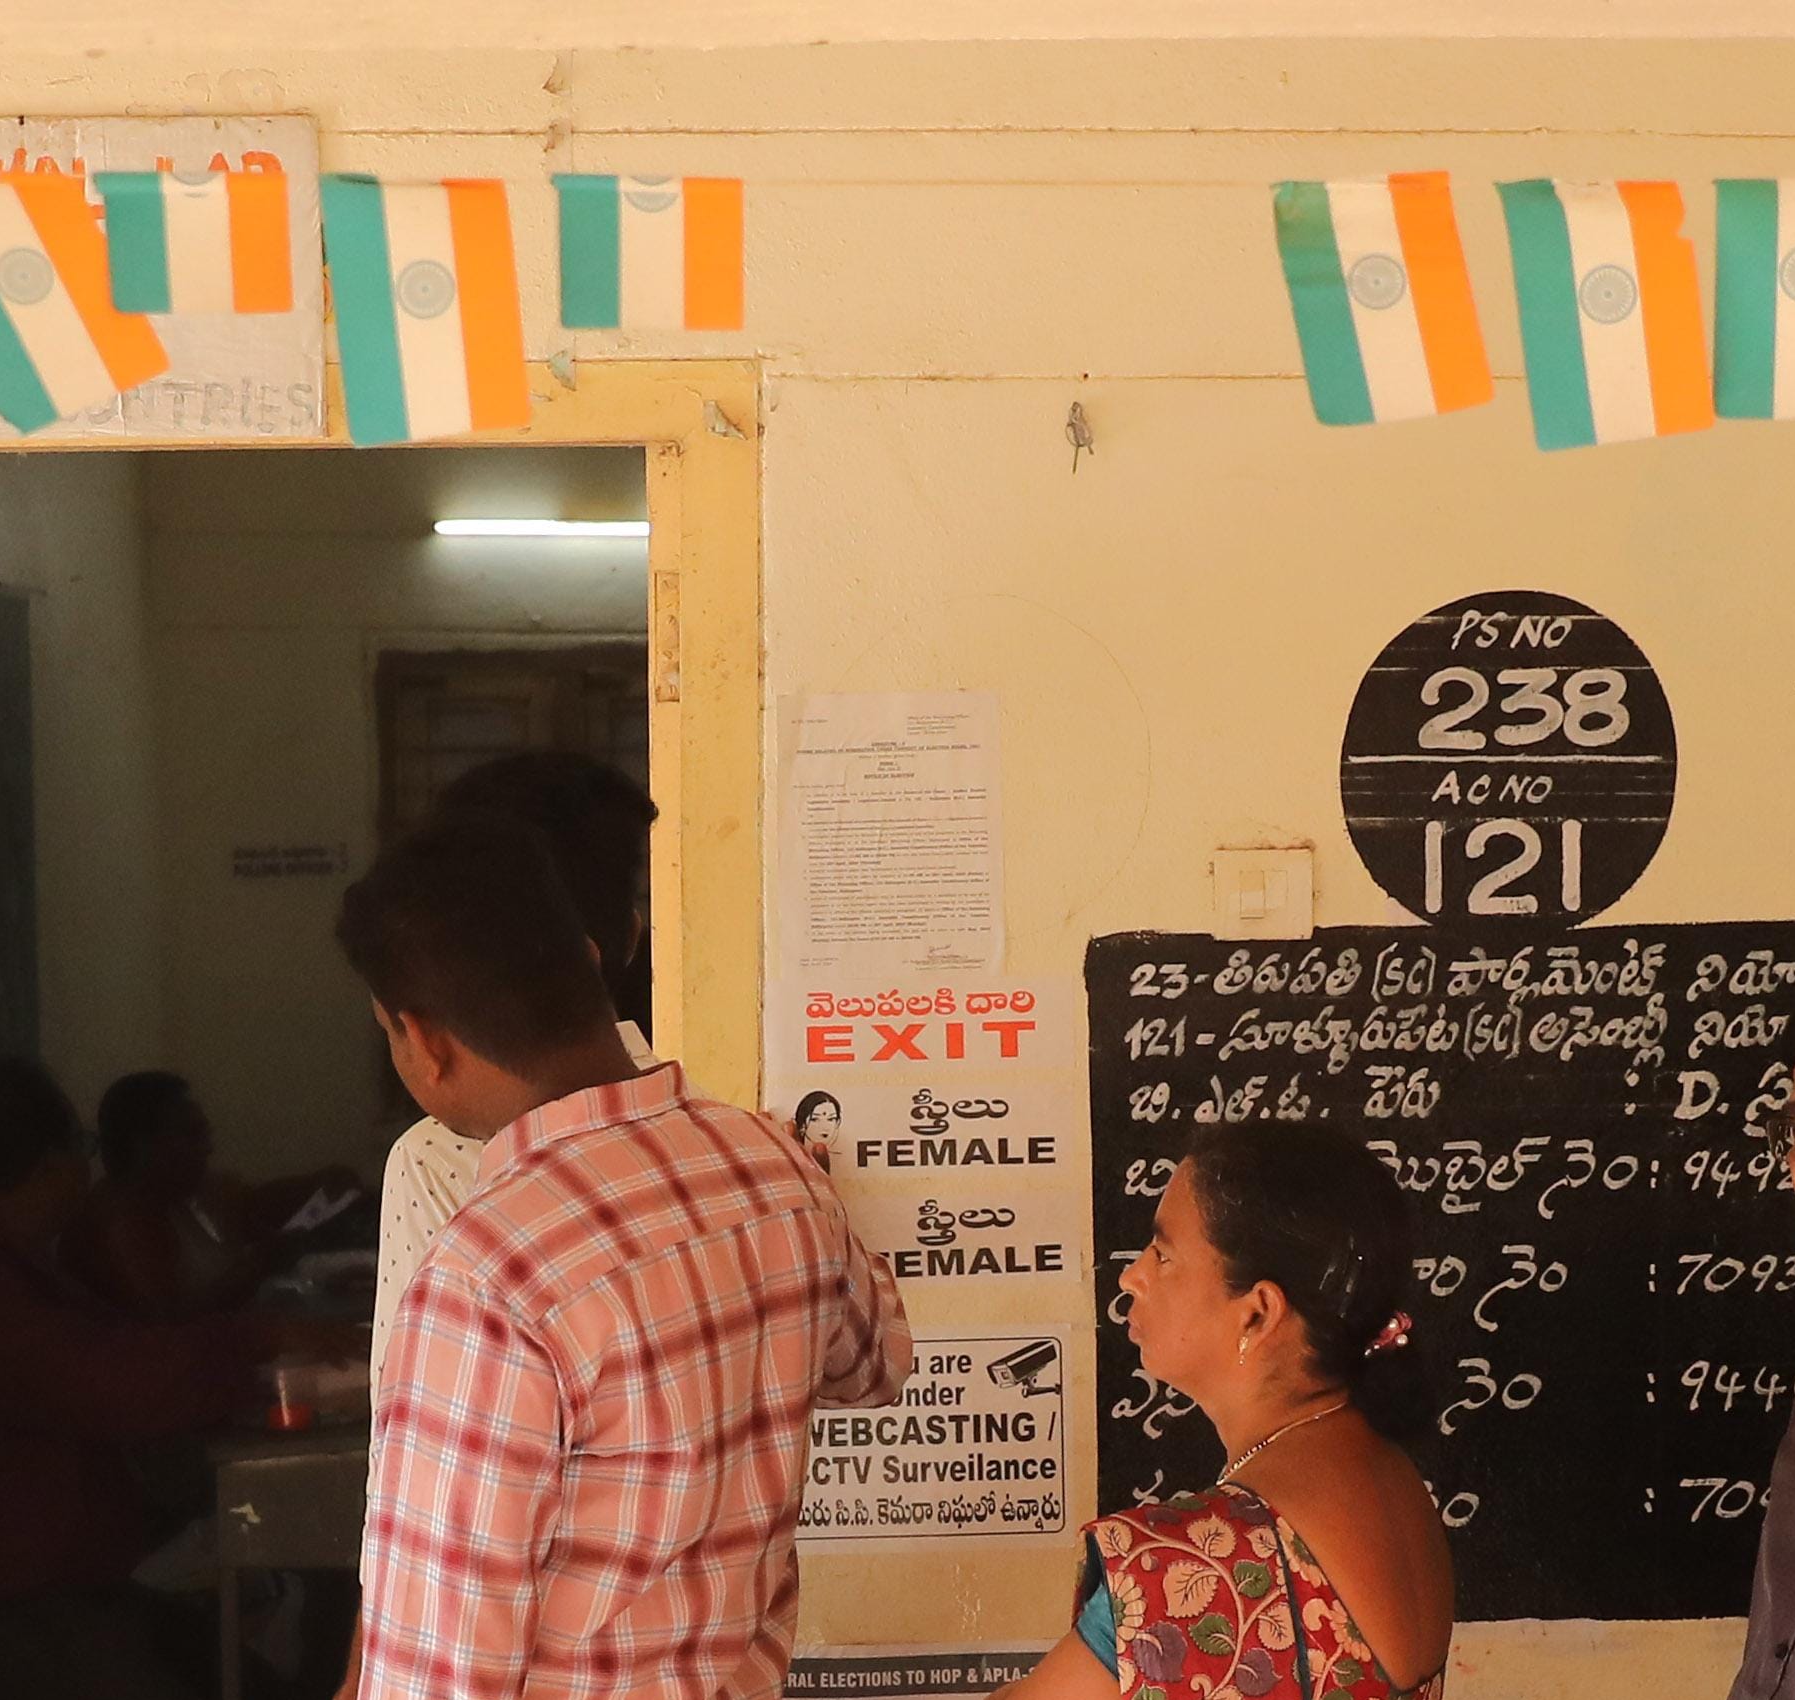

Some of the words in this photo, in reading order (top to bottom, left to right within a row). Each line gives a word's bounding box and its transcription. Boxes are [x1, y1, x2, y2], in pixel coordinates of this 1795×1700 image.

[1450, 609, 1508, 650] PS
[1509, 615, 1573, 649] NO
[1418, 666, 1631, 750] 238
[1499, 775, 1553, 803] NO
[1424, 819, 1583, 915] 121
[806, 988, 956, 1018] వెలుపలకి
[965, 989, 1035, 1015] దారి
[806, 1020, 1036, 1063] EXIT
[910, 1088, 1009, 1135] స్త్రీలు
[857, 1137, 1056, 1168] FEMALE
[916, 1199, 1016, 1246] స్త్రీలు
[930, 1354, 972, 1374] are
[883, 1453, 1056, 1484] Surveilance
[820, 1669, 902, 1689] ELECTIONS
[907, 1669, 926, 1685] TO
[930, 1668, 963, 1684] HOP
[966, 1668, 978, 1683] &
